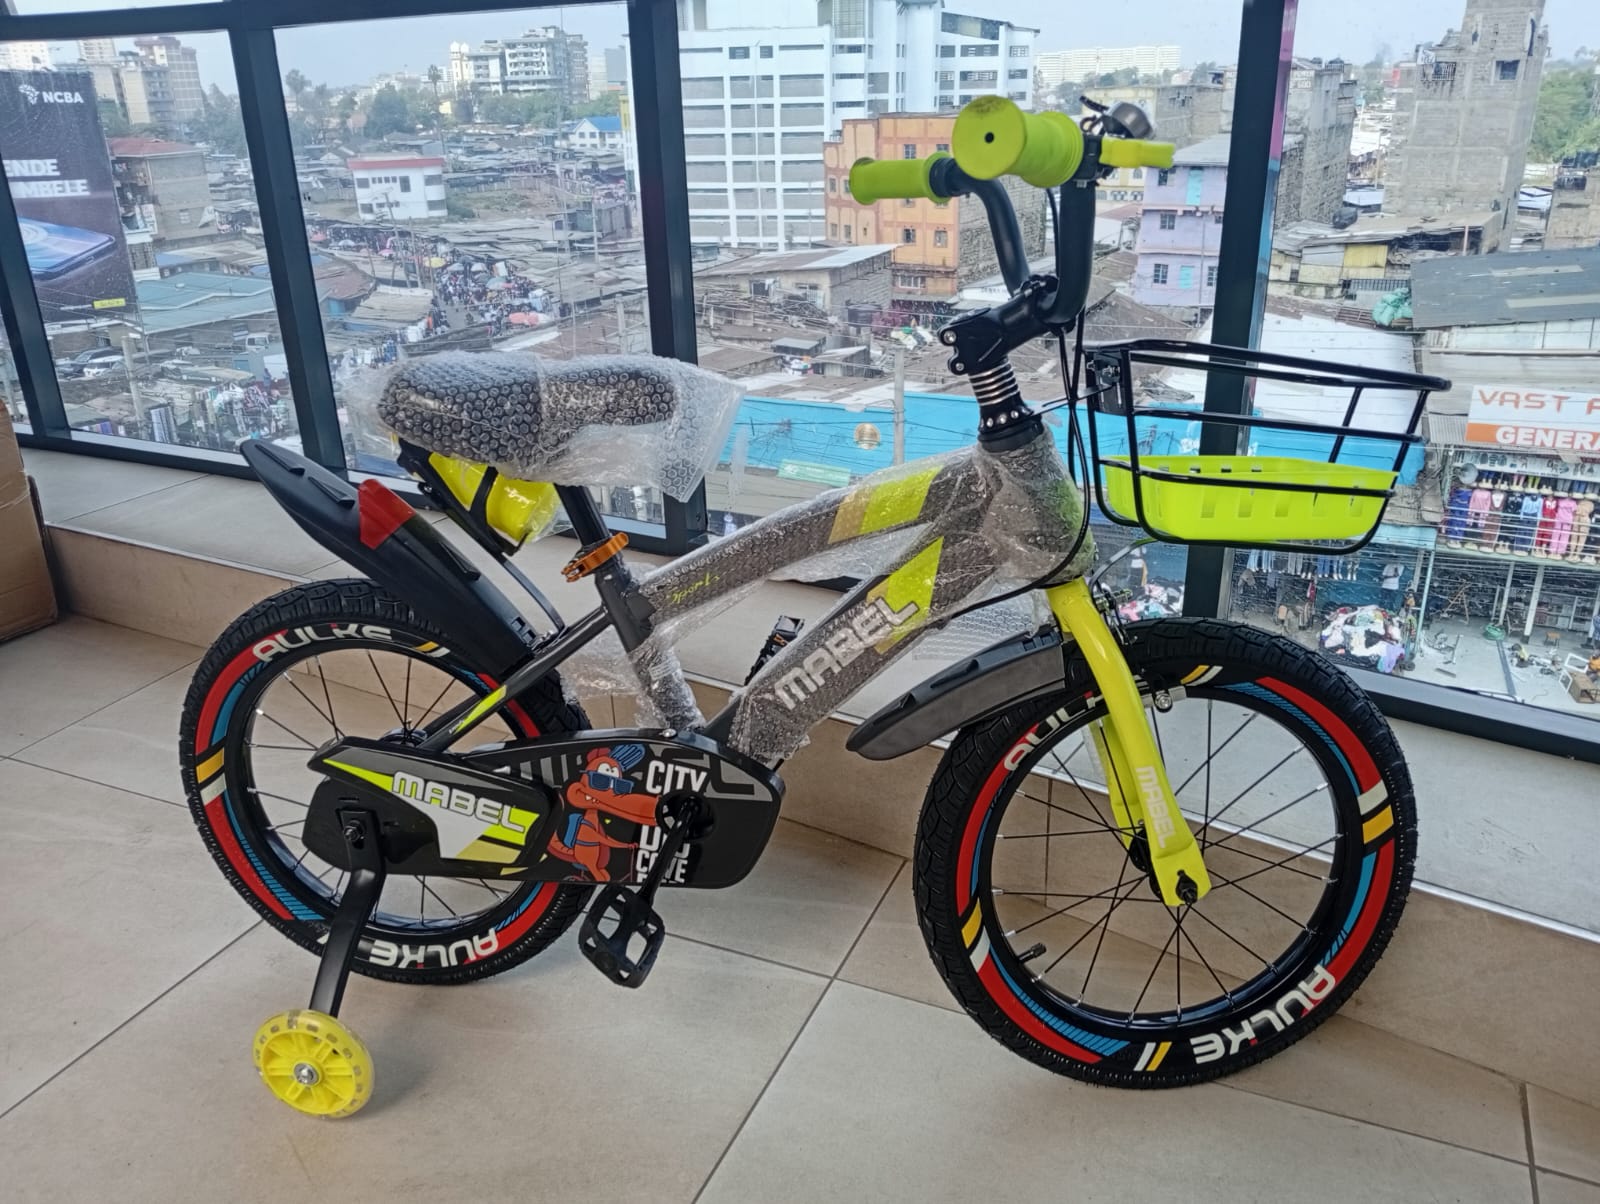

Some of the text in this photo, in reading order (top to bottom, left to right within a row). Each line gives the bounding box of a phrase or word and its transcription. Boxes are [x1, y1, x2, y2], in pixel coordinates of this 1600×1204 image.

[41, 91, 85, 104] NCBA
[1478, 389, 1572, 413] VAST
[773, 596, 920, 711] MABEL
[1003, 690, 1104, 772] AUL
[392, 770, 527, 834] MABEL
[1136, 765, 1176, 850] MABEL
